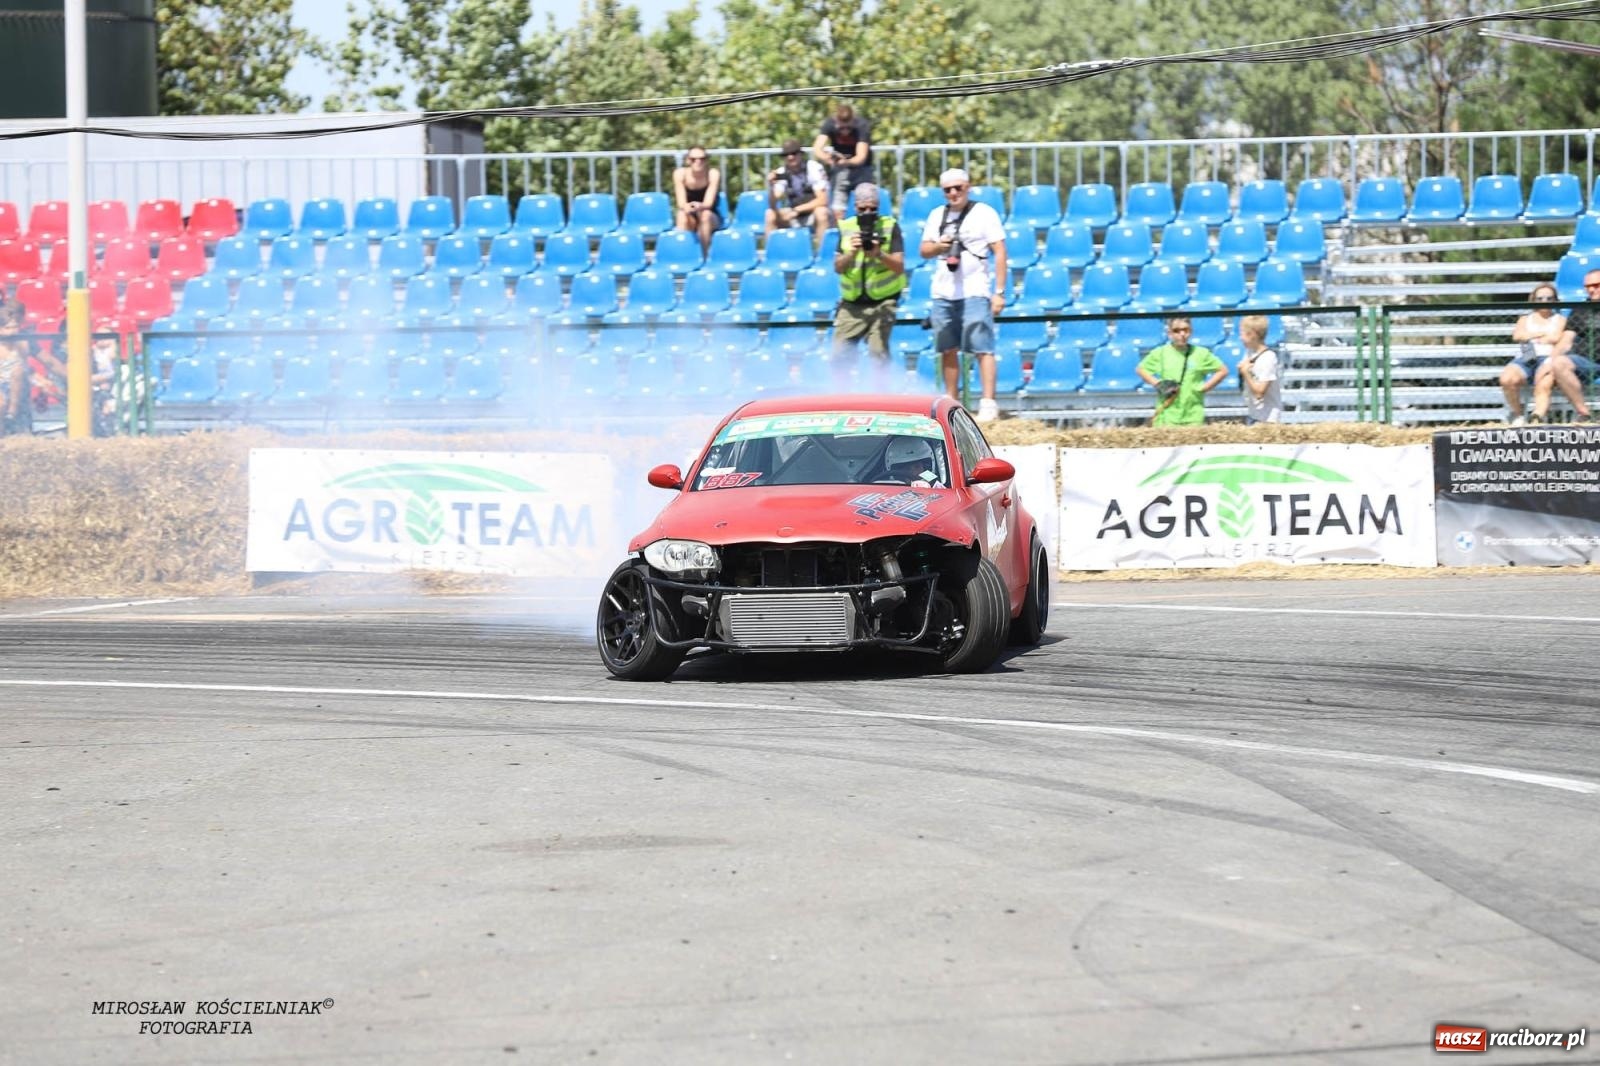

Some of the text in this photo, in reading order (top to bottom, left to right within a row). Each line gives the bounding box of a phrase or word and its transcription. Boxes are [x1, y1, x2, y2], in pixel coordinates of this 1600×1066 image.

[1451, 430, 1600, 444] IDEALNA OCHRONA
[1451, 449, 1456, 463] I
[1459, 448, 1556, 463] GWARANCJA
[1488, 470, 1499, 480] O
